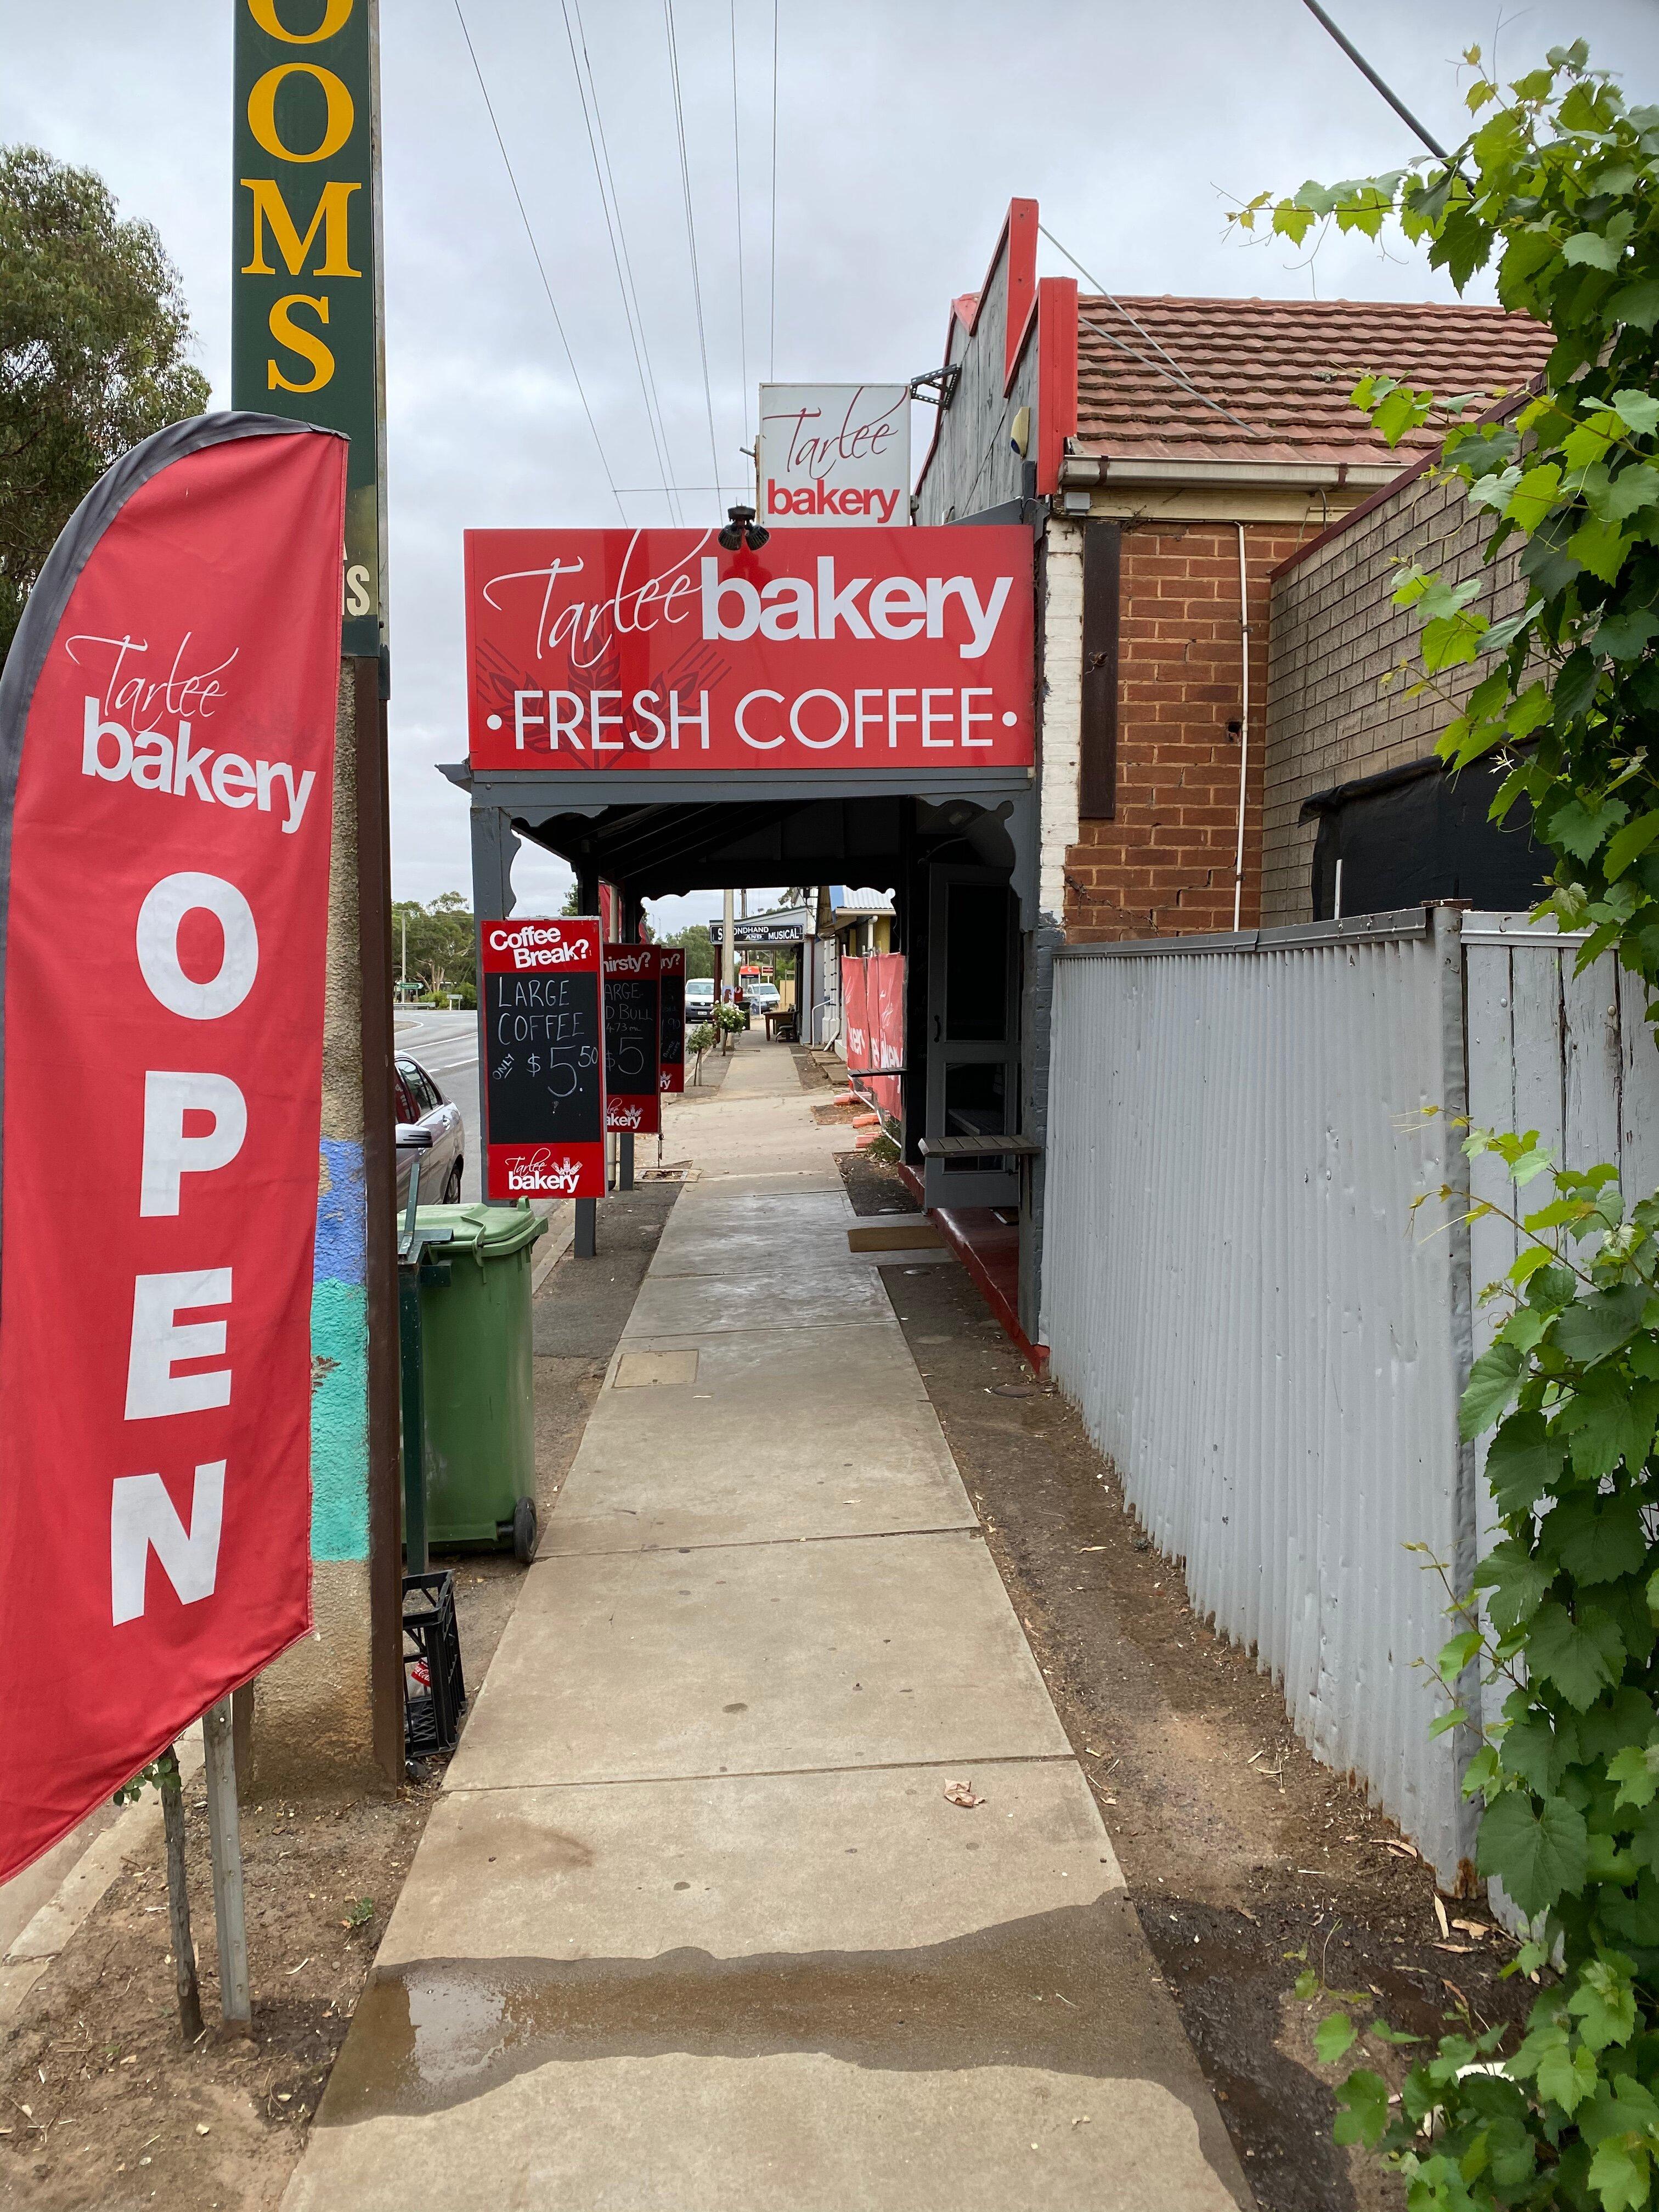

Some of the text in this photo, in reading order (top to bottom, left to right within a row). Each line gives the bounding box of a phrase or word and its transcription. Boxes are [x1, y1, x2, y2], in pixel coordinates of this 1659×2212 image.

[763, 386, 908, 480] Tarlee
[768, 479, 900, 523] bakery
[483, 529, 1014, 668] Tarlee bakery
[65, 631, 239, 733] Tarlee
[514, 687, 994, 750] FRESH COFFEE
[82, 695, 316, 834] bakery
[490, 926, 561, 951] Coffee
[768, 928, 799, 940] MUSICAL
[514, 939, 589, 969] Break?
[498, 977, 569, 1007] LARGE
[604, 983, 641, 1001] ARGE
[619, 1003, 653, 1020] BULL
[498, 1012, 585, 1044] COFFEE
[493, 1053, 515, 1080] ONLY
[606, 1113, 641, 1129] akery
[505, 1148, 551, 1177] Tarlee
[509, 1171, 579, 1193] bakery
[112, 871, 259, 1627] OPEN
